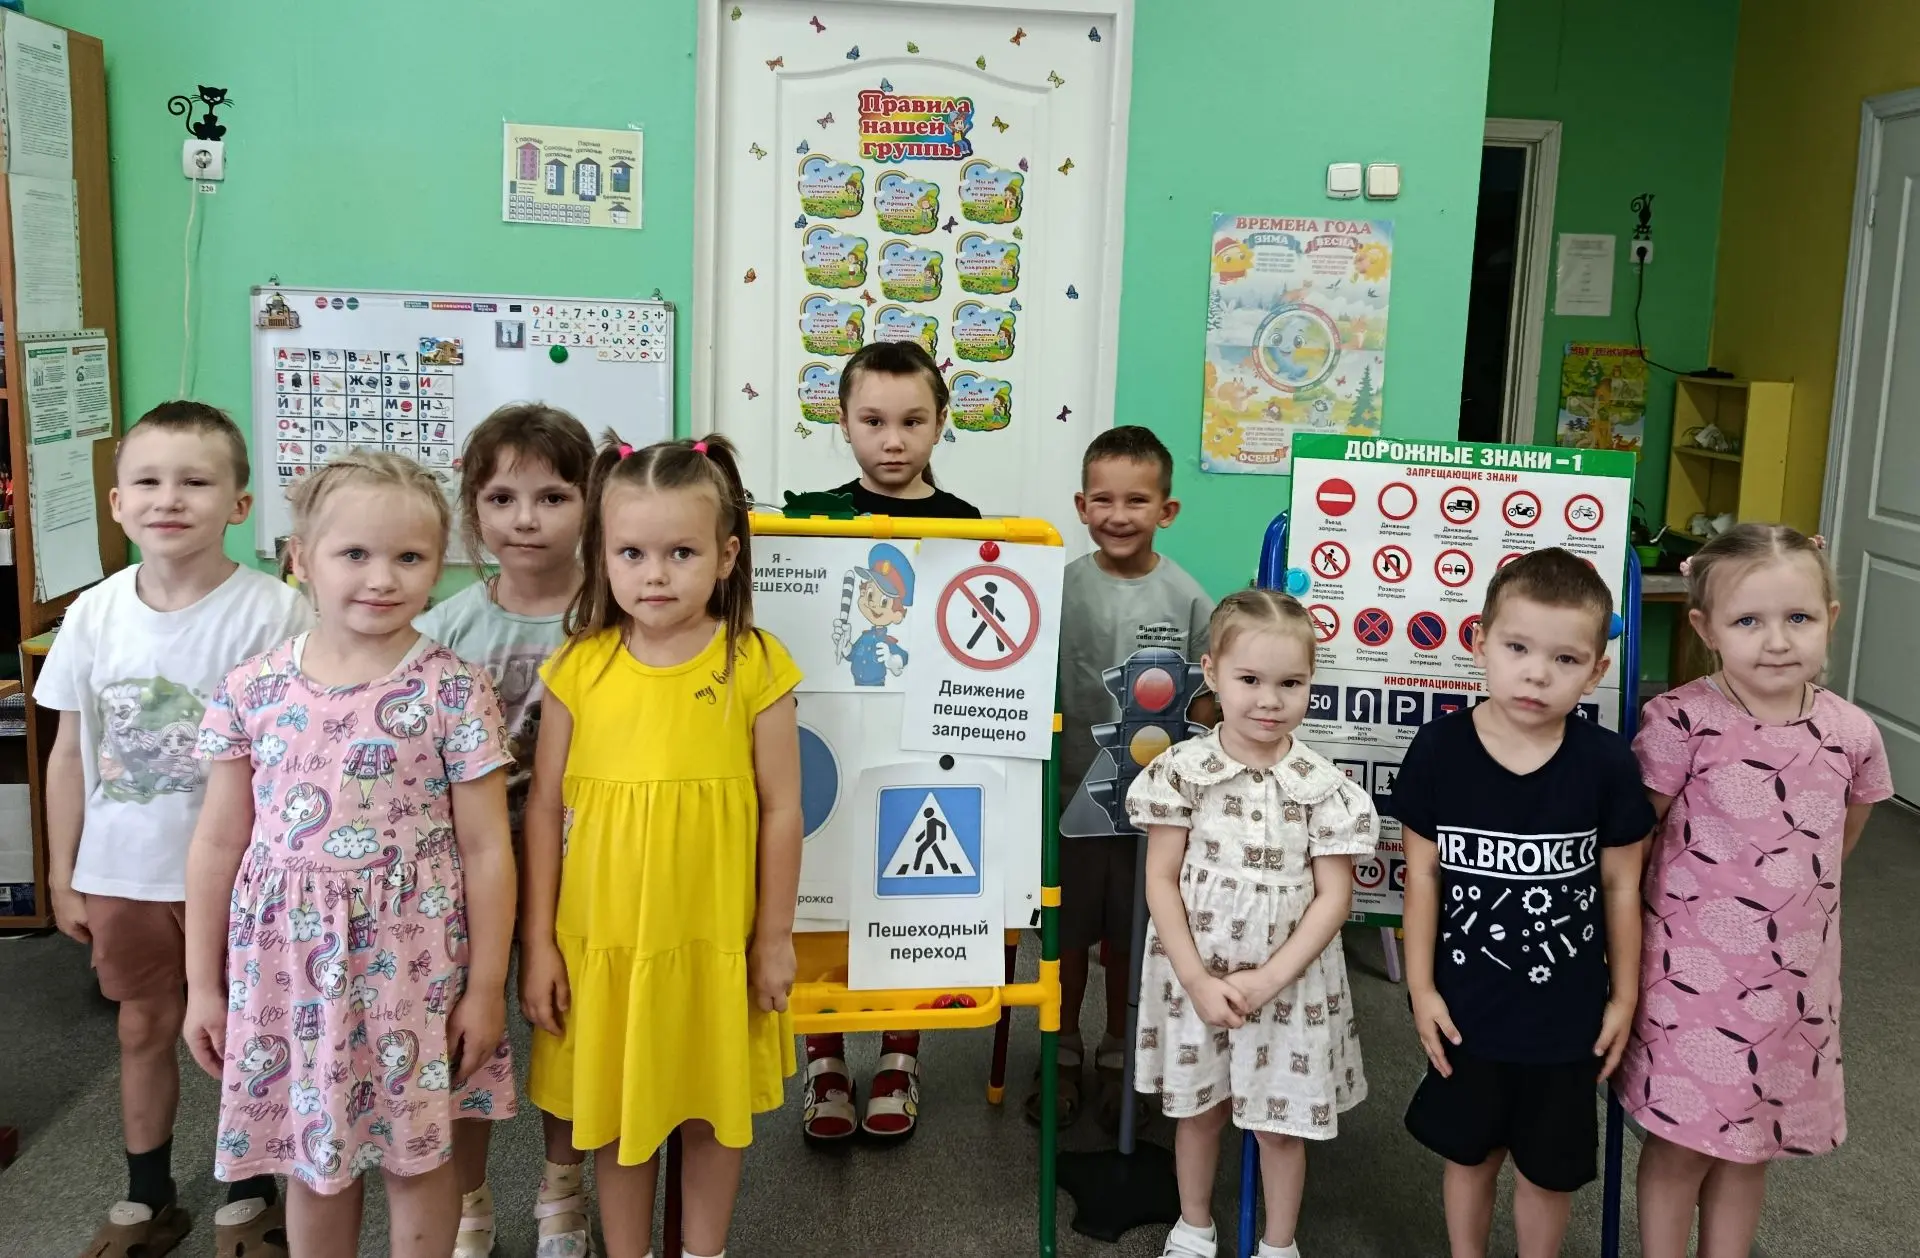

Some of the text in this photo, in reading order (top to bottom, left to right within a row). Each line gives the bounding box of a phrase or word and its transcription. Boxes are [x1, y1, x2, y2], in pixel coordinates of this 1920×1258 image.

[862, 94, 970, 116] Правила
[863, 118, 945, 134] нашей
[863, 142, 961, 159] группы
[1236, 217, 1372, 234] ВРЕМЕНА ГОДА
[1254, 234, 1289, 245] ЗИМА
[1316, 235, 1355, 247] ВЕСНА
[546, 306, 554, 316] 4
[574, 308, 581, 318] 7
[615, 309, 623, 319] 3
[628, 310, 635, 319] 2
[572, 334, 581, 344] 3
[312, 351, 321, 360] Б
[312, 372, 320, 385] Ё
[349, 375, 364, 385] Ж
[420, 377, 430, 387] И
[278, 395, 431, 410] Й К Л М Н
[313, 420, 324, 430] П
[1239, 453, 1279, 463] ОСЕНЬ
[1344, 440, 1474, 465] ДОРОЖНЫЕ
[1480, 448, 1552, 470] ЗНАКИ
[278, 466, 293, 476] Ш
[1406, 467, 1518, 483] ЗАПРЕЩАЮЩИЕ ЗНАКИ
[771, 553, 781, 563] Я
[751, 567, 827, 579] ИМЕРНЫЙ
[752, 582, 819, 594] ЕШЕХОД!
[939, 679, 1026, 700] Движение
[1384, 676, 1482, 692] ИНФОРМАЦИОННЫЕ
[694, 685, 717, 705] my
[1309, 694, 1332, 710] 50
[933, 701, 1029, 722] пешеходов
[932, 723, 1027, 742] запрещено
[281, 754, 333, 774] Hello
[1437, 832, 1576, 873] MR.BROKE
[1358, 865, 1378, 878] 70
[798, 895, 834, 906] рожка
[1352, 889, 1386, 897] Ограничение
[868, 920, 989, 939] Пешеходный
[890, 945, 967, 963] переход
